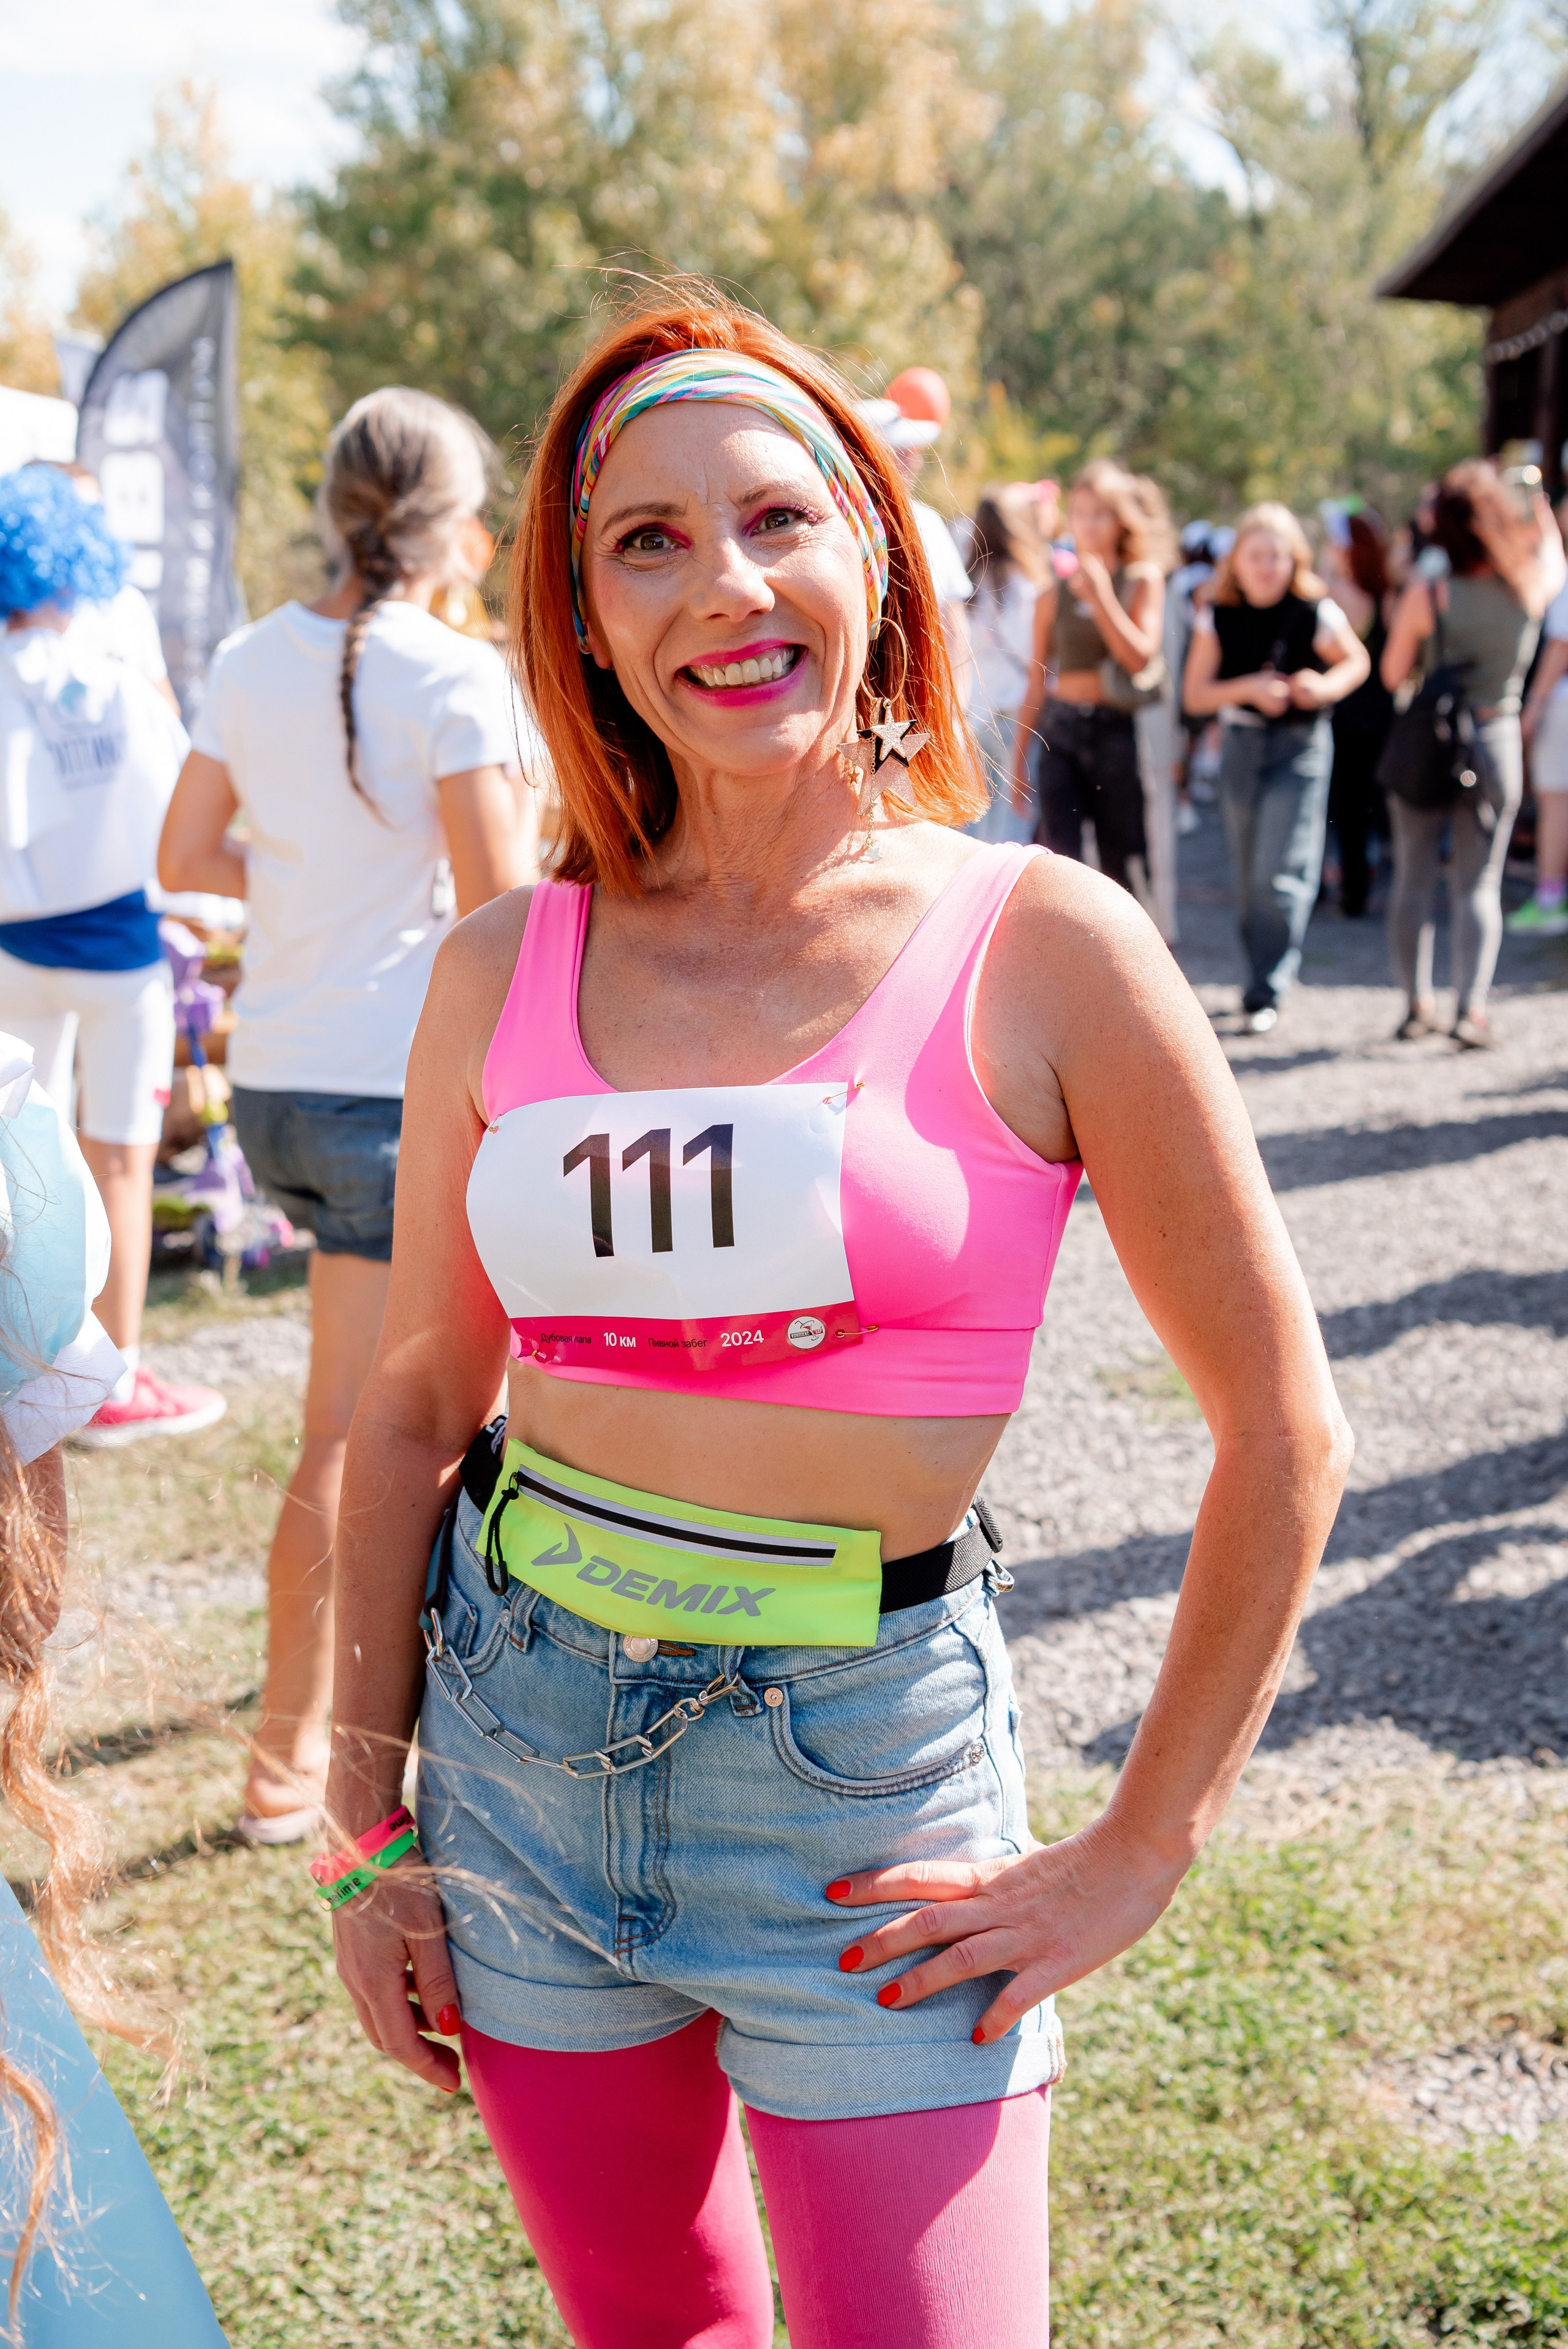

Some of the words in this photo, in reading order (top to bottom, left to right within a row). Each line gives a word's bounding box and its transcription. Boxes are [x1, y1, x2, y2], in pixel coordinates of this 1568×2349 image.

[563, 1123, 735, 1257] 111
[541, 1333, 573, 1344] Дубовая
[574, 1335, 592, 1344] лапа
[603, 1332, 617, 1346] 10
[648, 1338, 679, 1348] Пивной
[681, 1338, 707, 1348] забег
[720, 1330, 764, 1347] 2024
[576, 1556, 776, 1617] DEMIX
